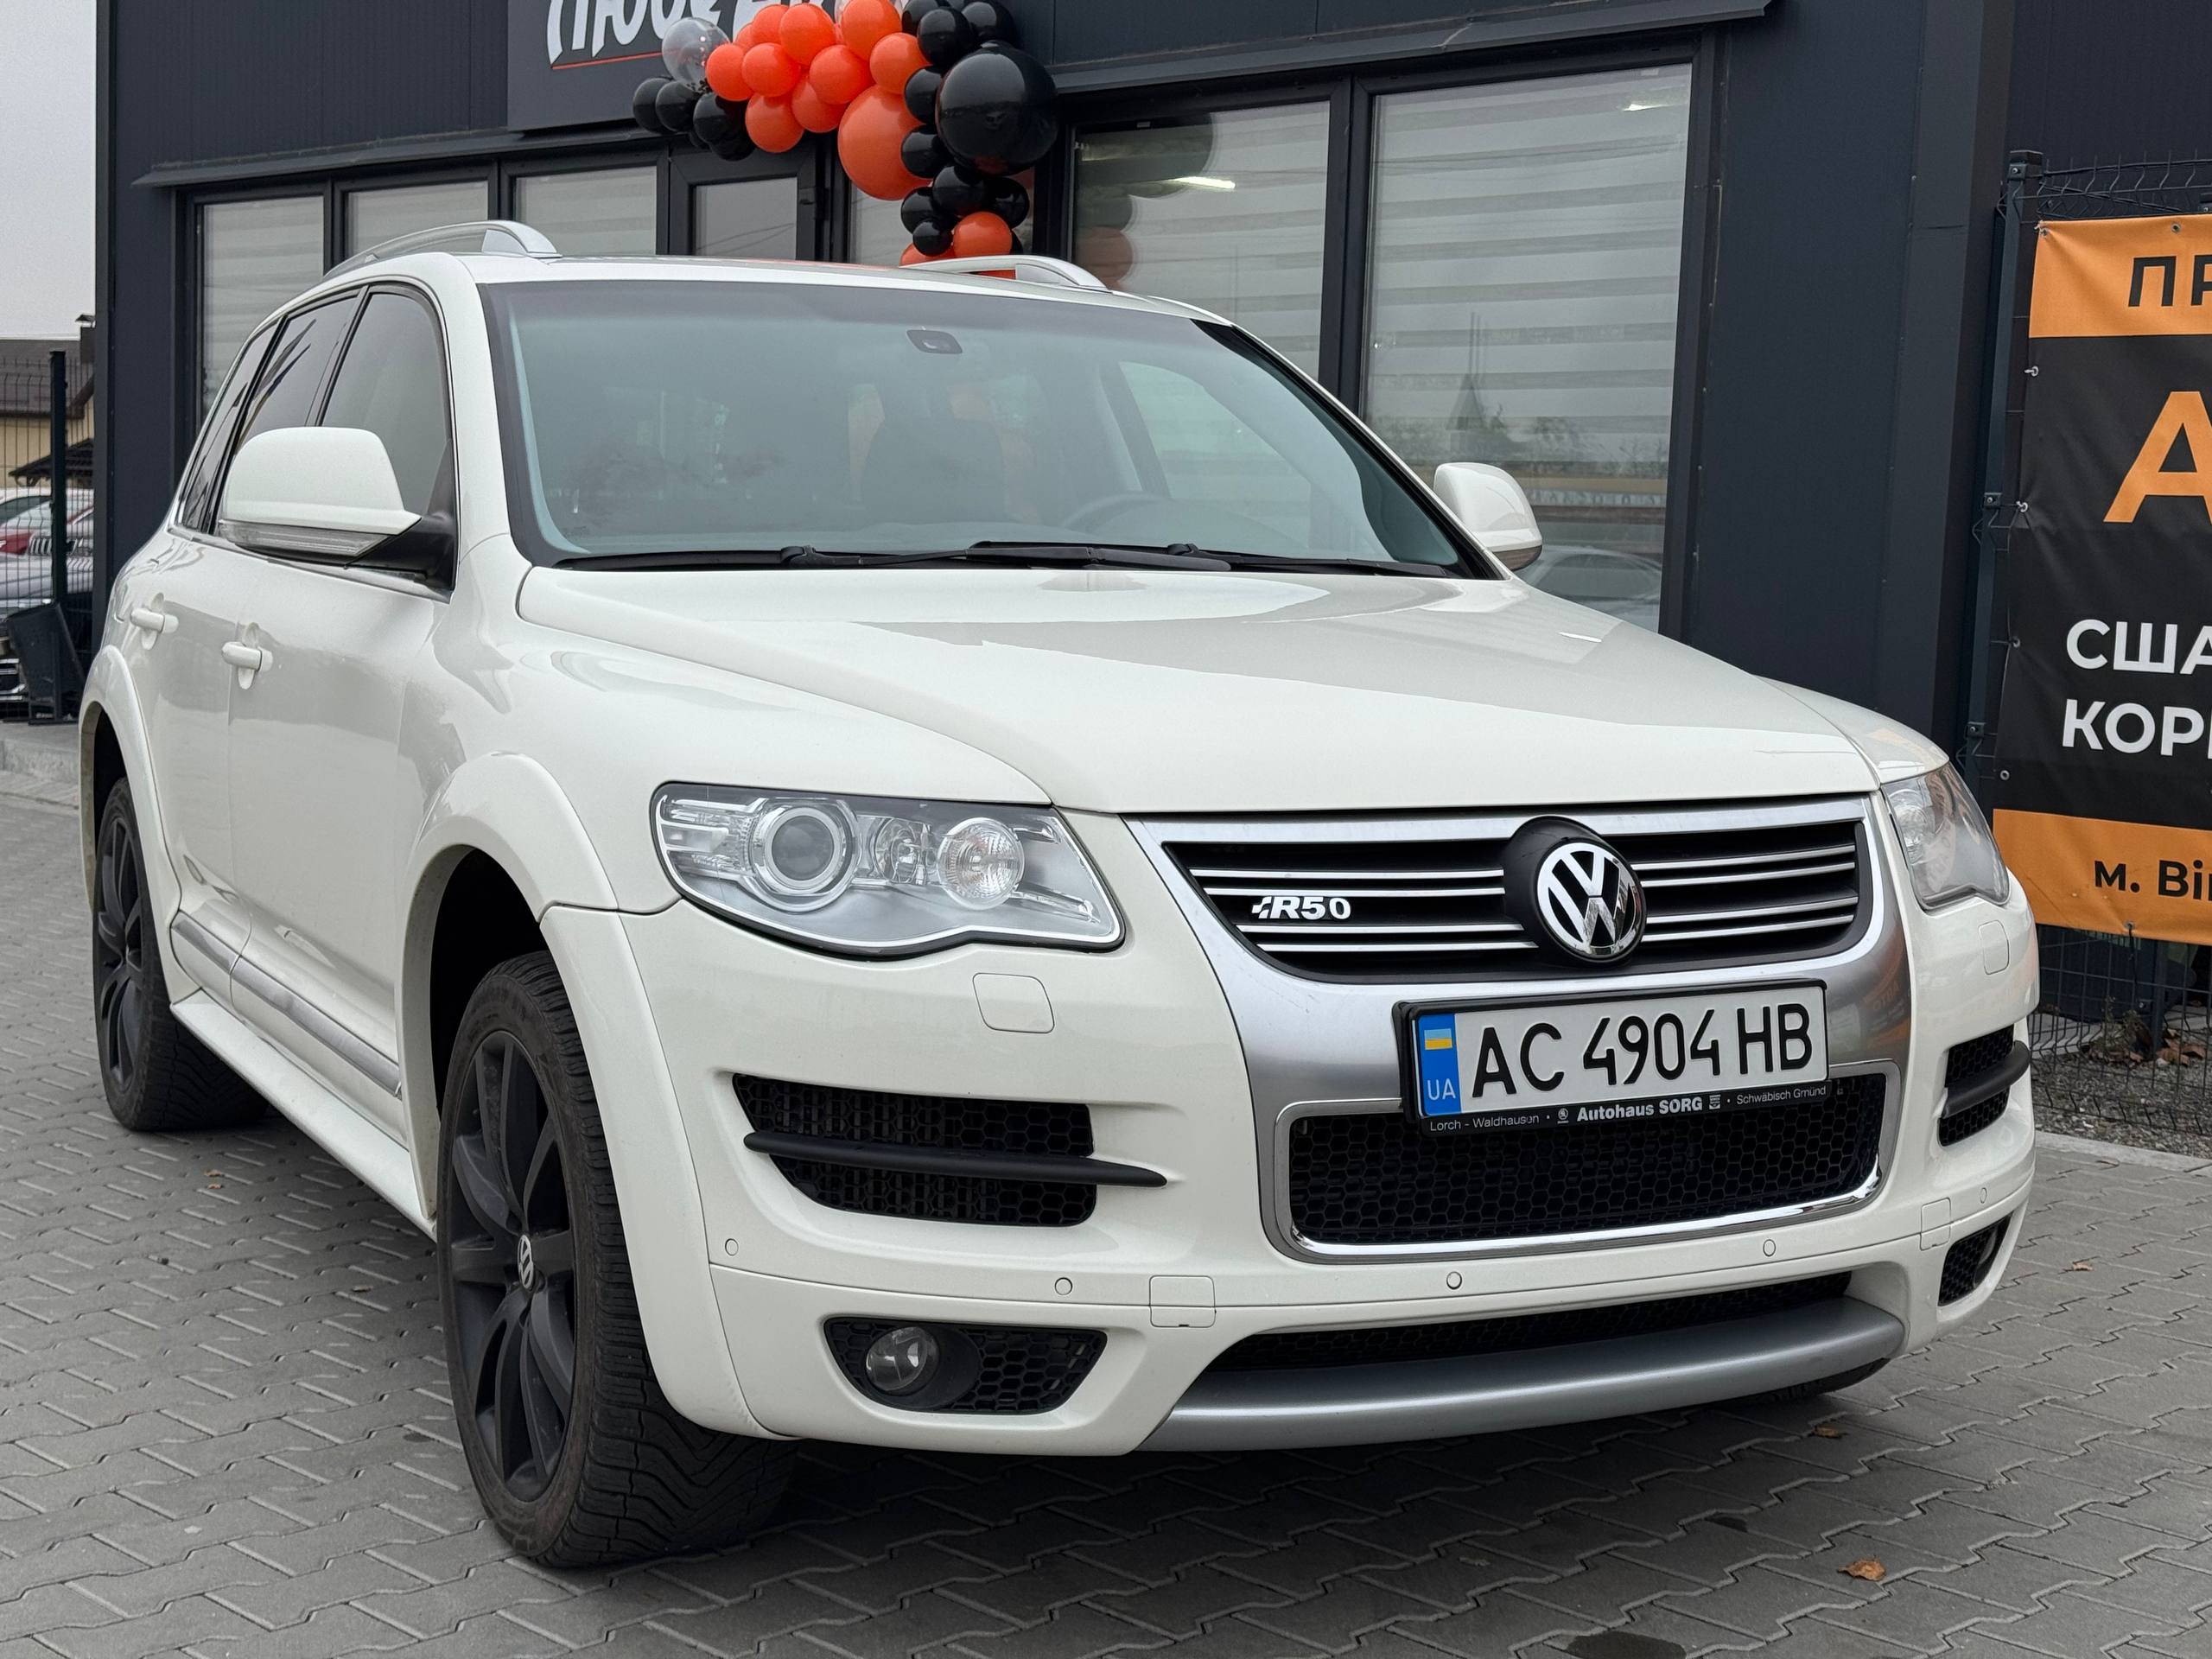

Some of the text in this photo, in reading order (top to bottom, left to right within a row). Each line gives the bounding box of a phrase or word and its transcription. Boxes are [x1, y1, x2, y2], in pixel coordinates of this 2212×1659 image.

[2063, 698, 2212, 760] КОР
[2094, 860, 2212, 901] м. Ві
[1269, 896, 1351, 920] R50
[1472, 1003, 1813, 1098] AC 4904 HB
[1427, 1077, 1457, 1101] UA
[1430, 1119, 1461, 1132] Lorch
[1472, 1114, 1540, 1128] Waldhausen
[1577, 1103, 1655, 1122] Autohaus
[1659, 1096, 1703, 1116] SORG
[1736, 1089, 1791, 1105] Schwäbisch
[1793, 1085, 1827, 1099] Gmünd
